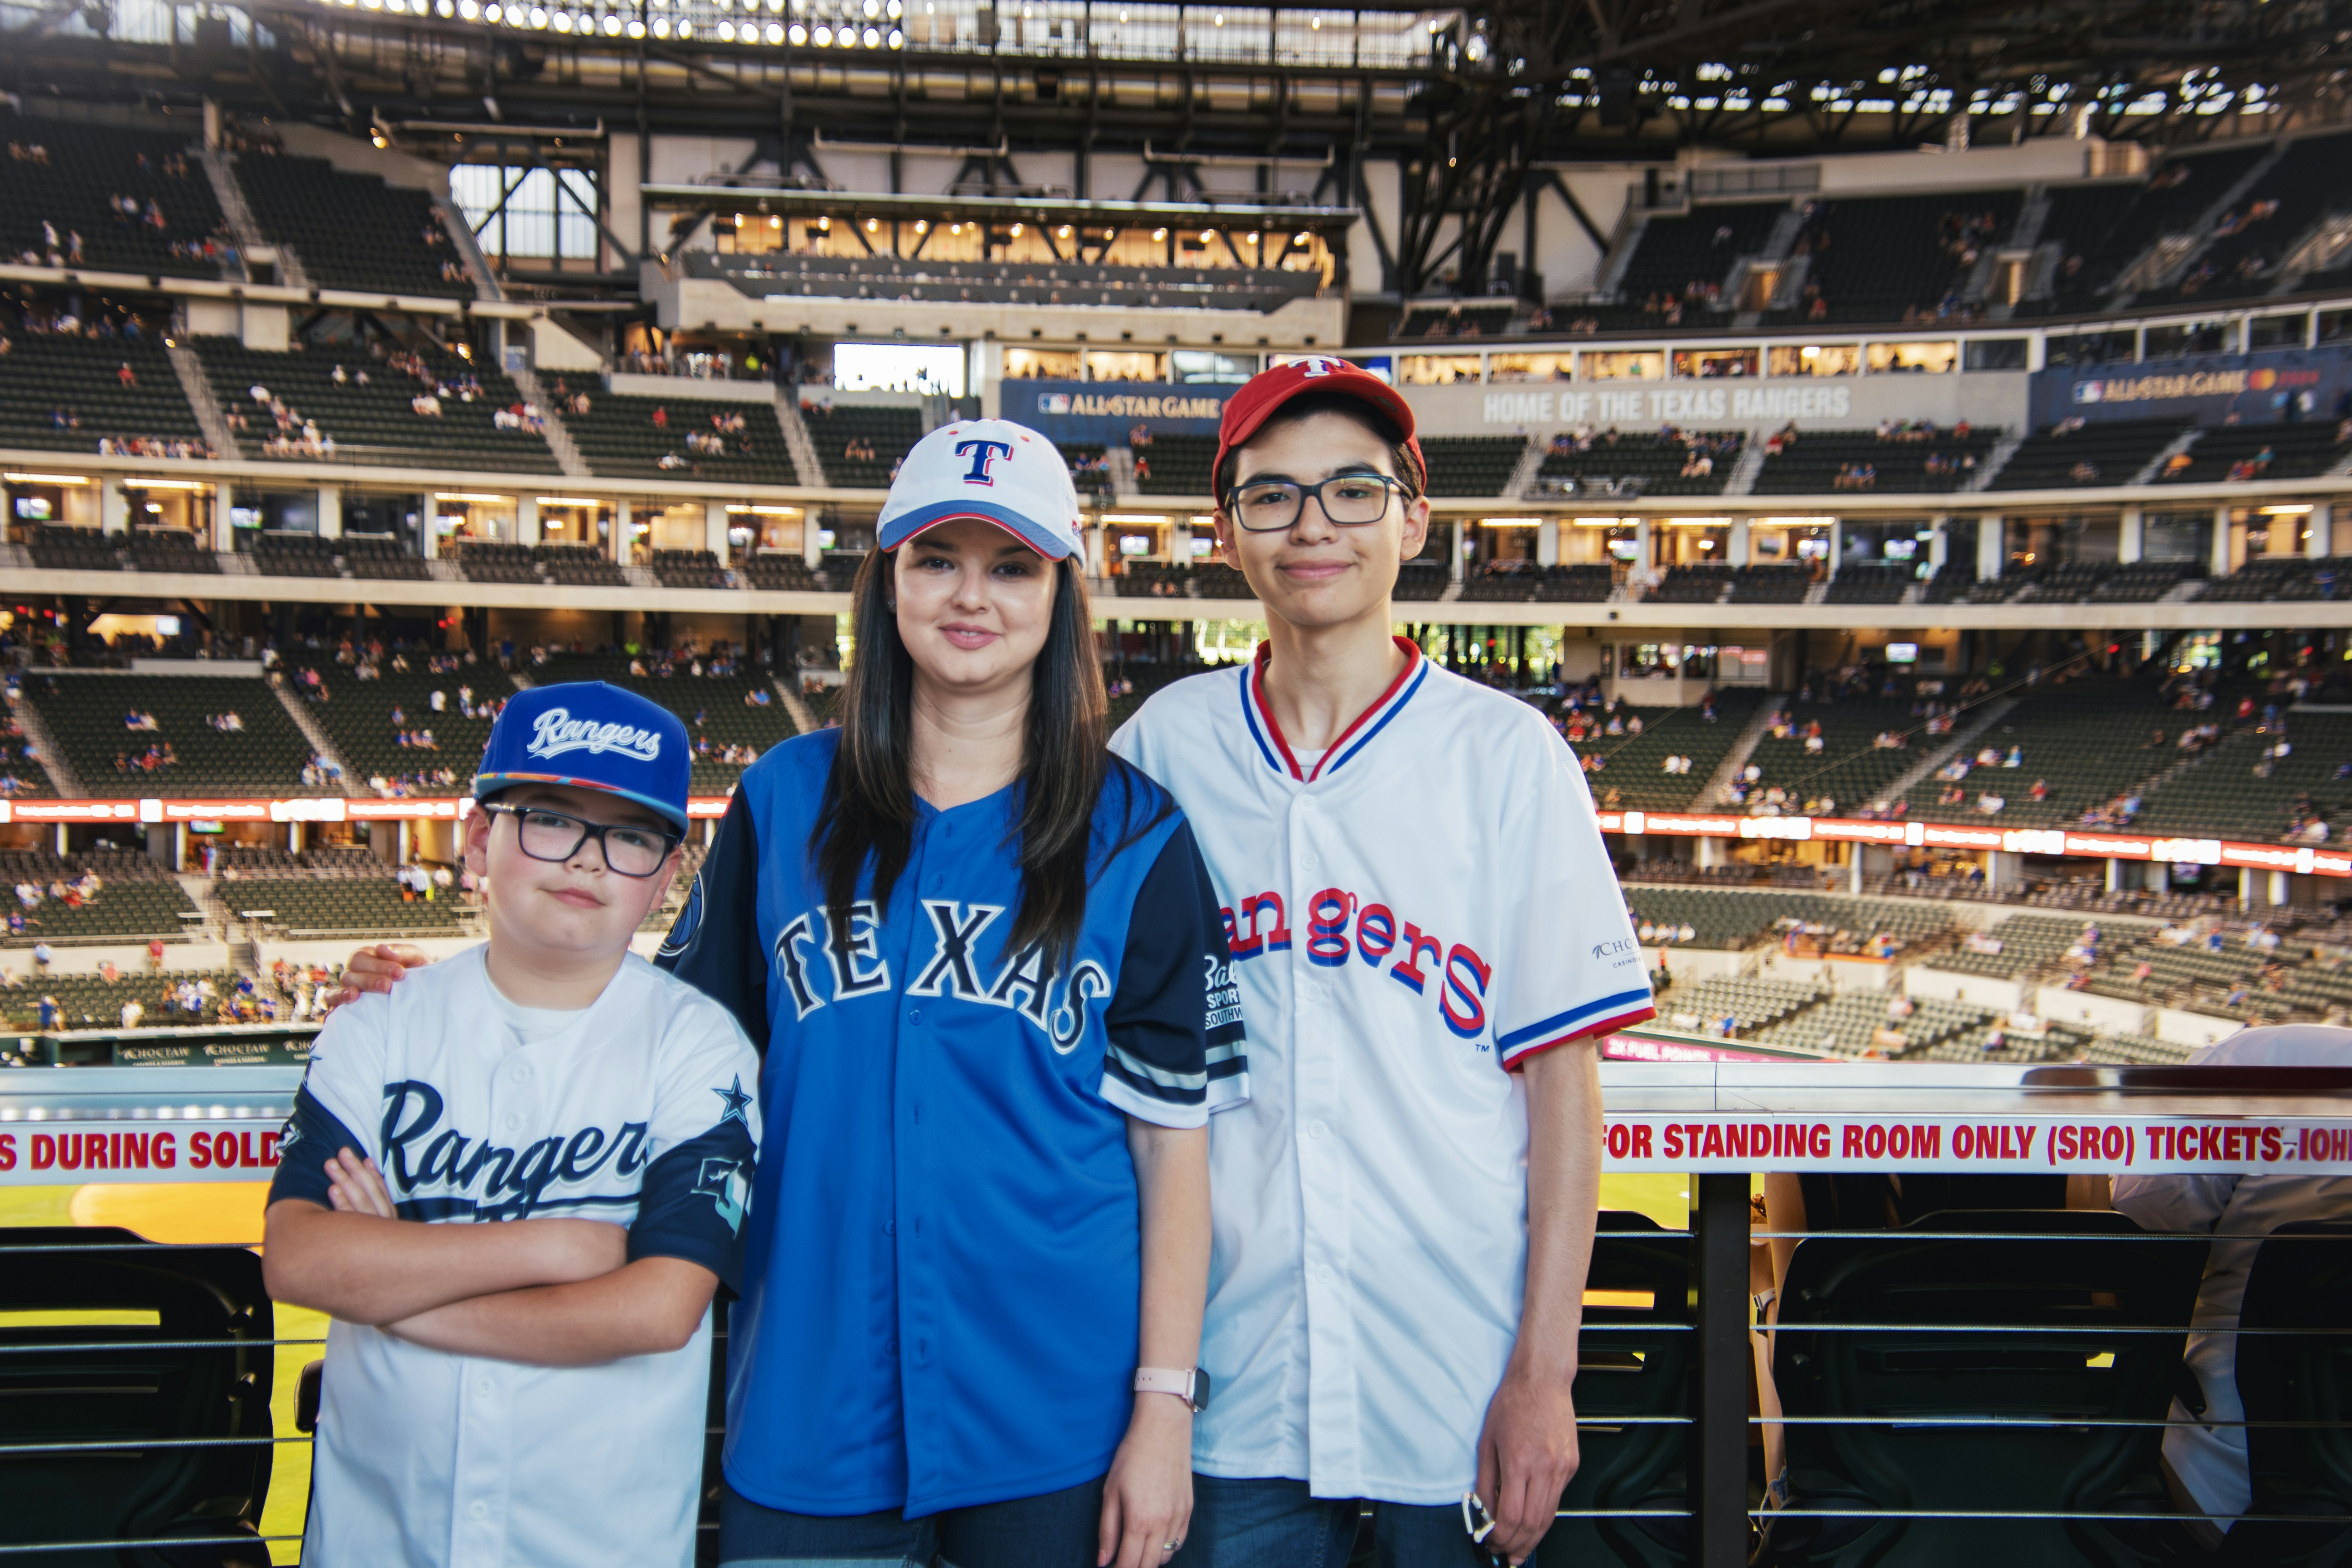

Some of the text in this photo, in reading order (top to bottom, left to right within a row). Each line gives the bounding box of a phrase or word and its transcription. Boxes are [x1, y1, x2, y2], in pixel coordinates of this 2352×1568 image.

[1287, 356, 1345, 378] T
[1161, 396, 1220, 419] GAME
[1484, 385, 1851, 423] HOME OF THE TEXAS RANGERS
[955, 439, 1014, 487] T
[526, 707, 662, 761] Rangers
[775, 900, 1111, 1055] TEXAS
[1207, 988, 1240, 1009] SPOR
[1475, 1044, 1490, 1052] TM
[30, 1132, 176, 1171] DURING
[188, 1131, 281, 1169] SOLD
[1663, 1124, 1831, 1158] STANDING
[1842, 1124, 1941, 1159] ROOM
[1952, 1124, 2037, 1160] ONLY
[2047, 1125, 2135, 1167] (SRO)
